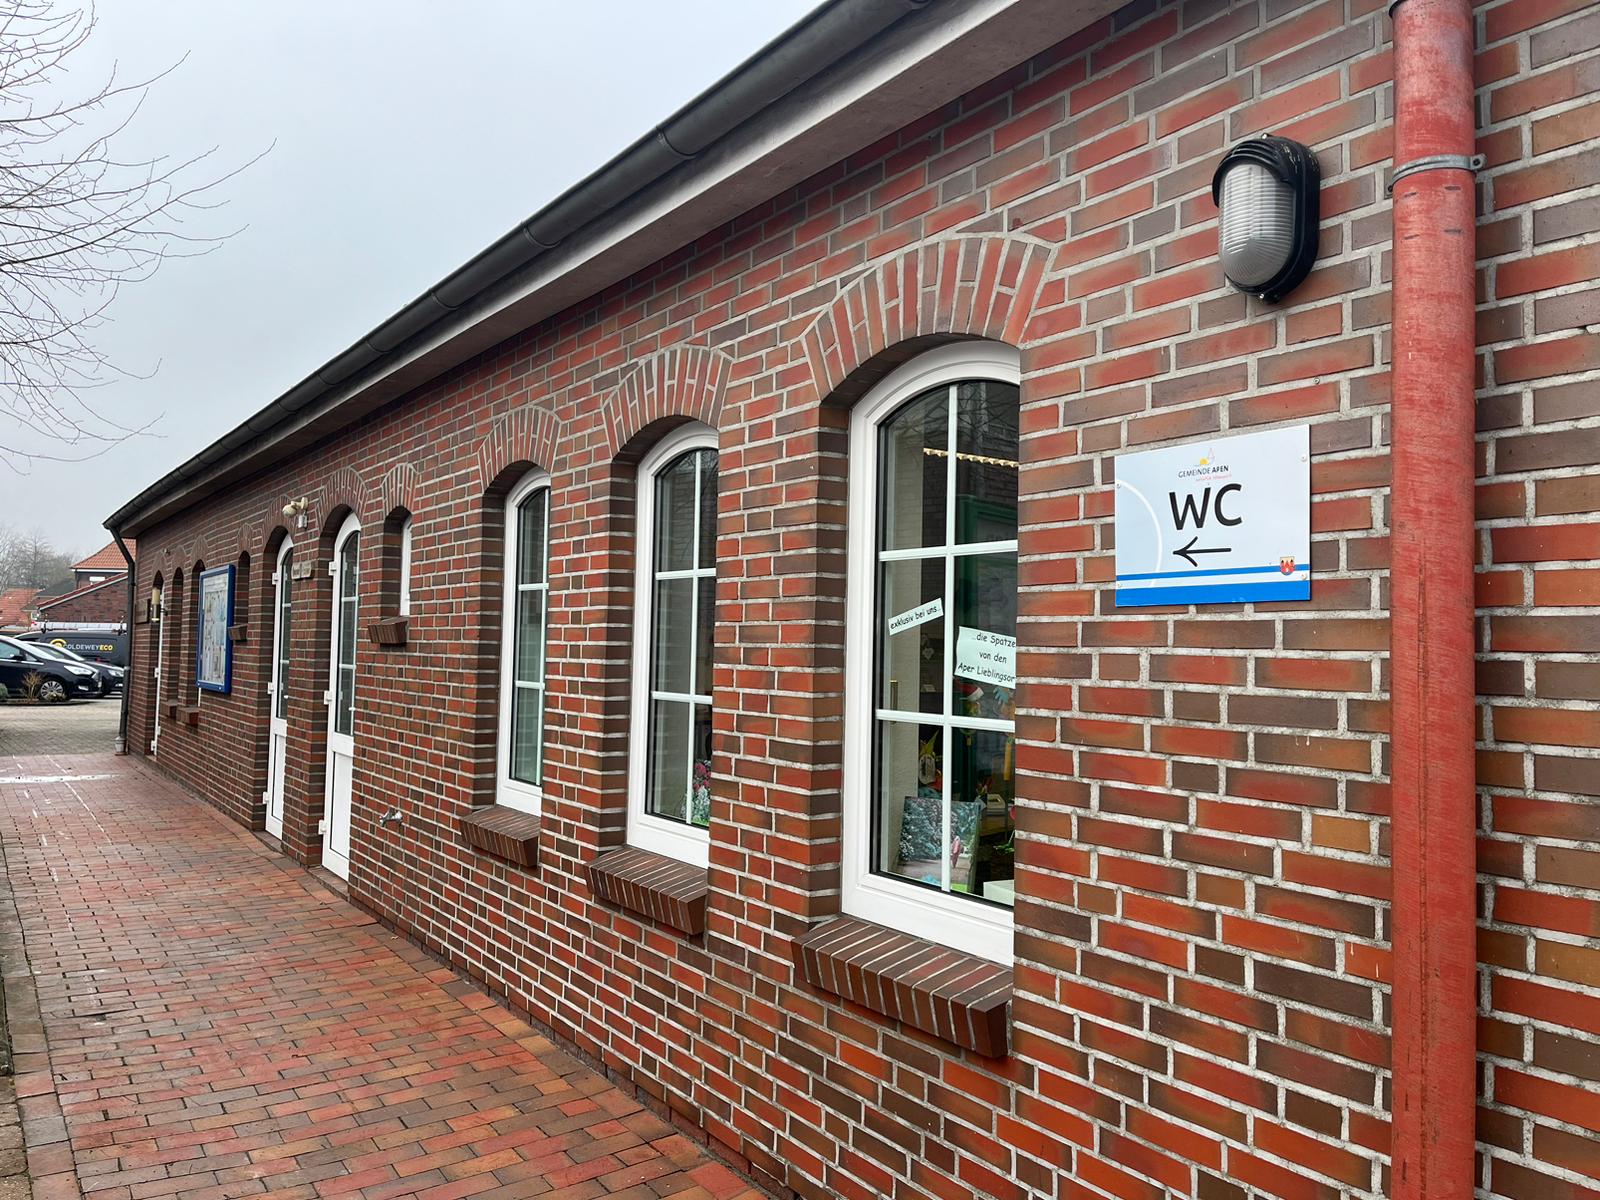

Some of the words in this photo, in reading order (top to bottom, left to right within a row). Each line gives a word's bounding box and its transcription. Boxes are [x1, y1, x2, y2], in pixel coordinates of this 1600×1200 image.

[1178, 467, 1210, 478] GEMEINDE
[1212, 465, 1229, 473] APEN
[1169, 483, 1243, 531] WC
[890, 614, 914, 630] exklusiv
[915, 610, 926, 620] bei
[979, 652, 991, 660] von
[993, 653, 1007, 664] den
[958, 662, 975, 673] Aper
